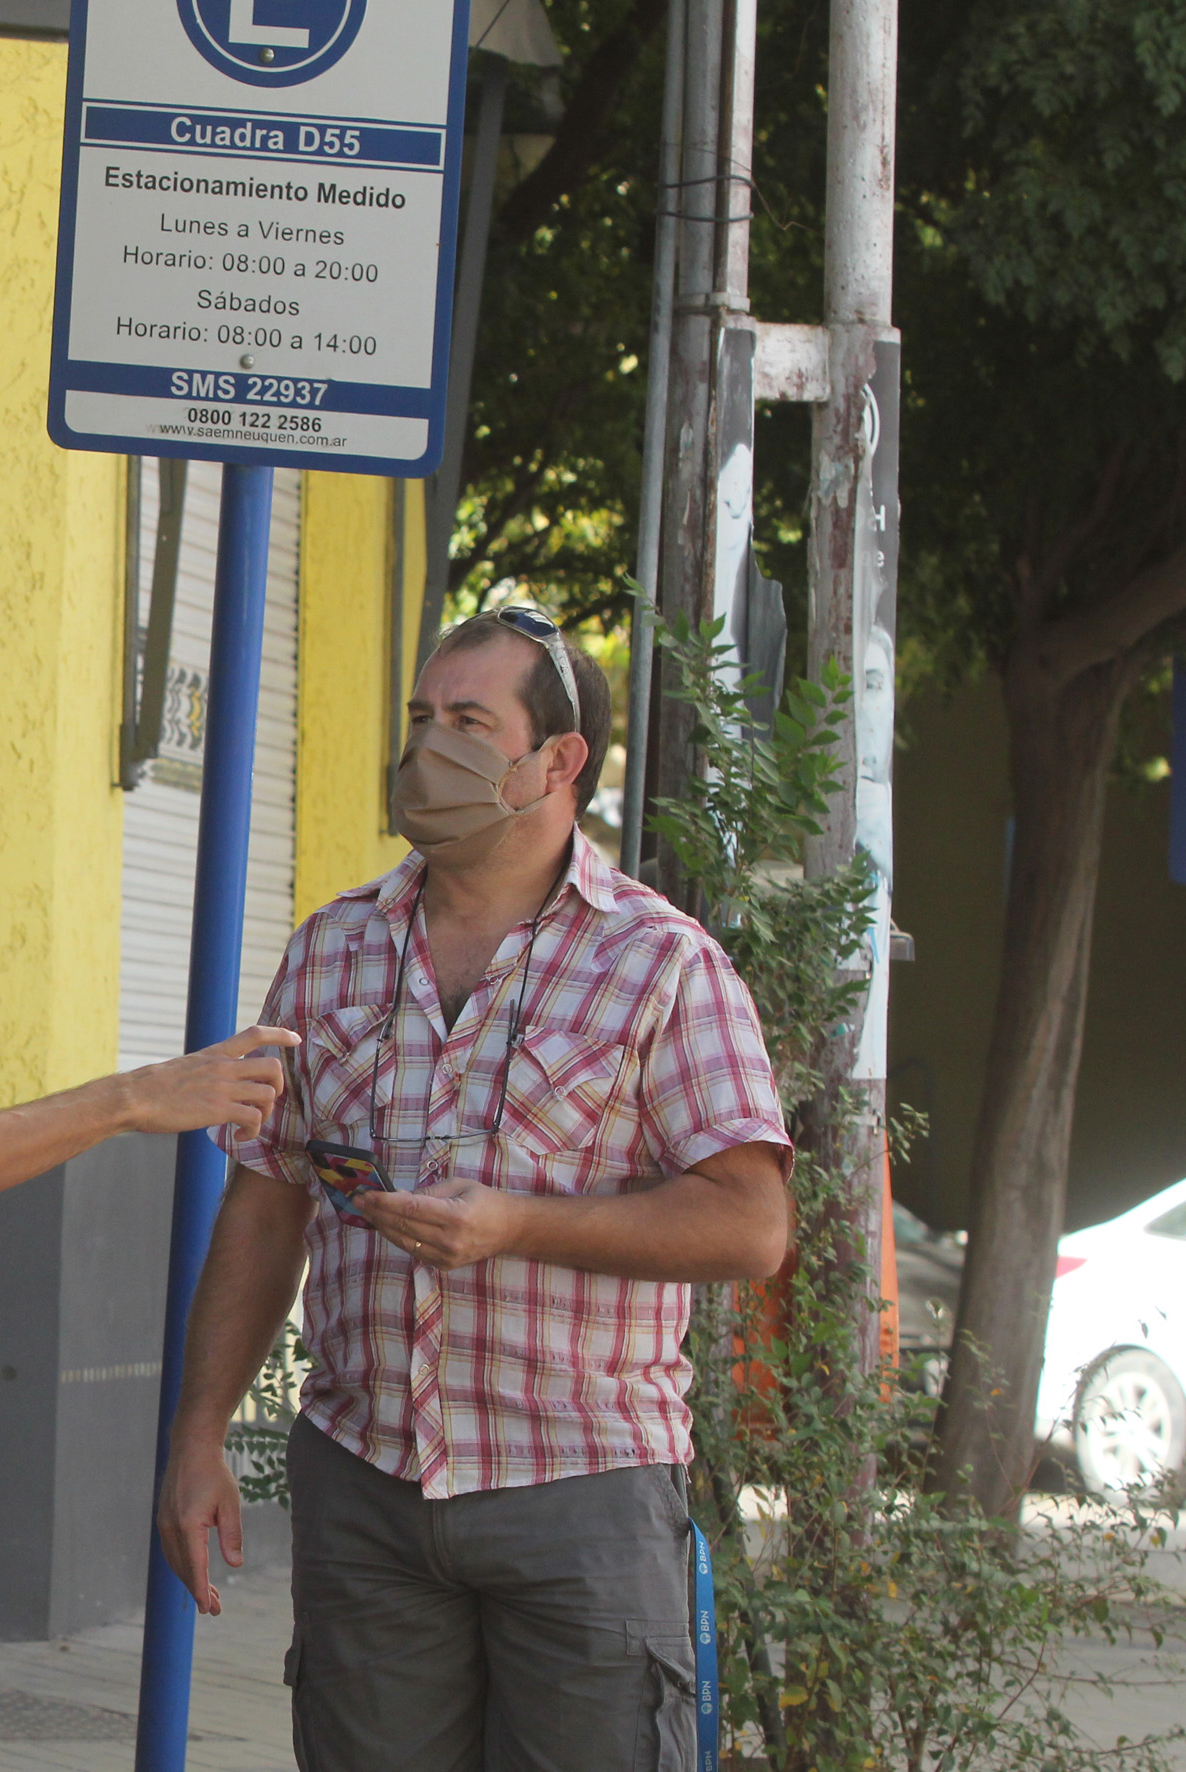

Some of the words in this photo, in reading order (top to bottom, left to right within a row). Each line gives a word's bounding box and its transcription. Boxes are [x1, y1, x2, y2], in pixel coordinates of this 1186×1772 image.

[170, 116, 284, 151] Cuadra
[298, 126, 361, 156] D55
[104, 166, 309, 202] Estacionamiento
[317, 182, 406, 210] Medido
[160, 213, 229, 237] Lunes
[236, 223, 249, 238] a
[258, 220, 344, 246] Viernes
[123, 245, 213, 270] Horario:
[222, 252, 286, 276] 08:00
[293, 263, 306, 277] a
[314, 260, 378, 283] 20:00
[197, 289, 300, 316] Sábados
[116, 316, 208, 342] Horario:
[217, 324, 282, 348] 08:00
[290, 335, 303, 350] a
[314, 332, 377, 356] 14:00
[170, 371, 236, 400] SMS
[246, 376, 328, 406] 22937
[187, 407, 232, 426] 0800
[239, 411, 271, 429] 122
[277, 414, 322, 433] 2586
[698, 1541, 708, 1562] BPN
[700, 1610, 710, 1632] BPN
[701, 1680, 711, 1702] BPN
